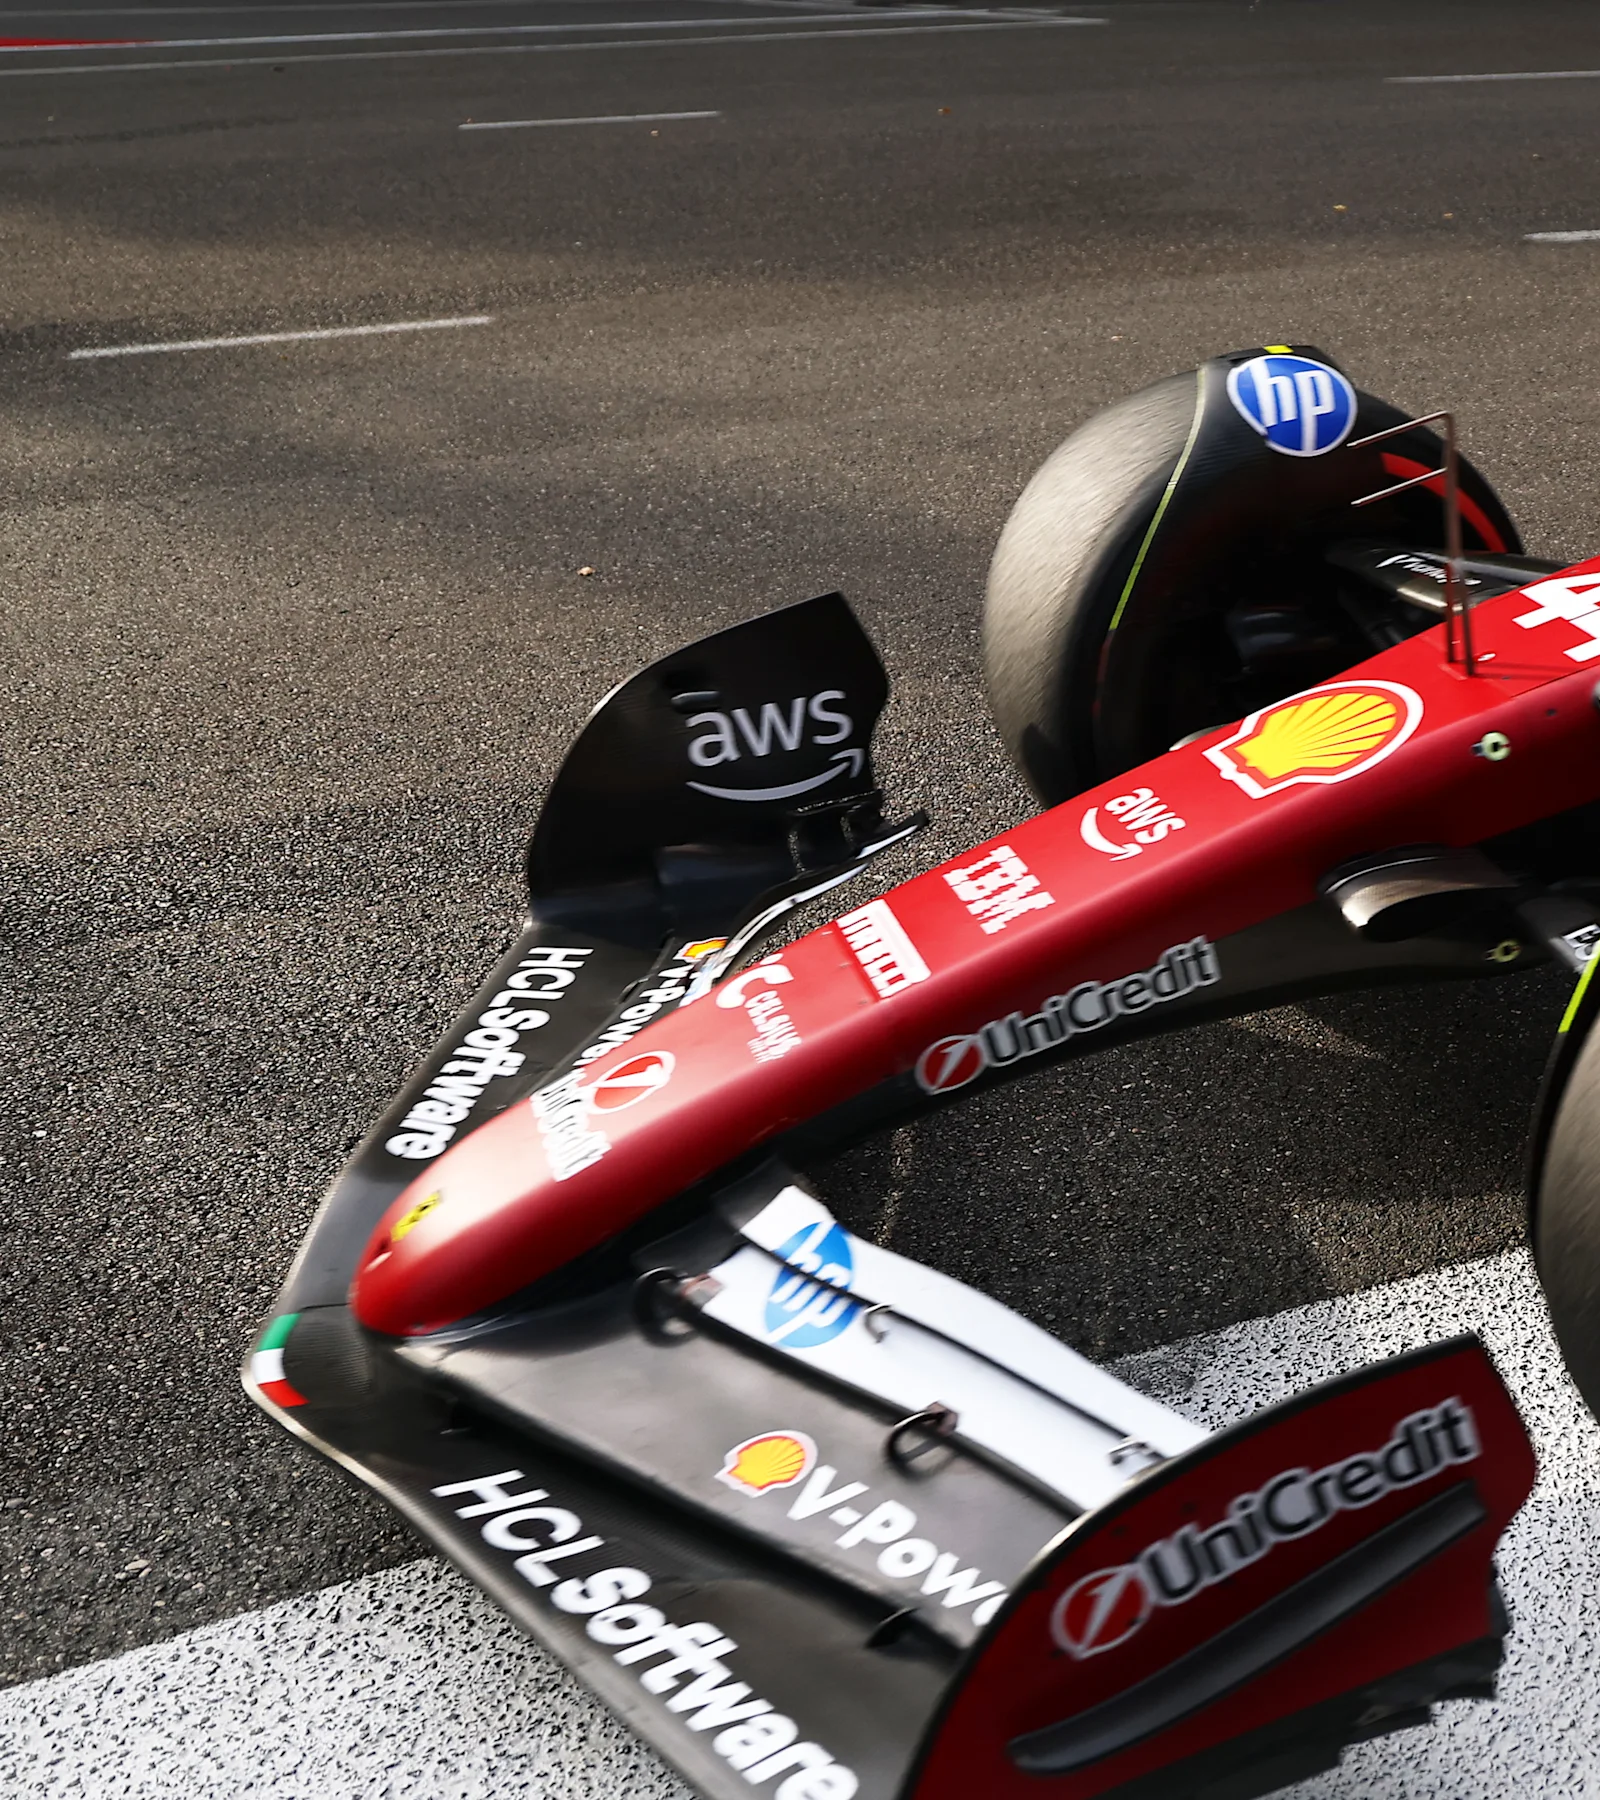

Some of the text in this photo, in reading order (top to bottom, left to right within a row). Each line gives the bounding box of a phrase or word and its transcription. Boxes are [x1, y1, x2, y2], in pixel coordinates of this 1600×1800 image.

[685, 690, 852, 767] aws
[1105, 787, 1186, 843] aws
[943, 845, 1056, 935] IBM
[836, 899, 931, 1000] PIRELLI
[980, 934, 1223, 1066] UniCredit
[384, 945, 594, 1160] HCLSoftware
[744, 991, 802, 1057] CELSIUS
[770, 1222, 848, 1345] hp
[1137, 1395, 1484, 1607] UniCredit
[431, 1469, 859, 1800] HCLSoftware
